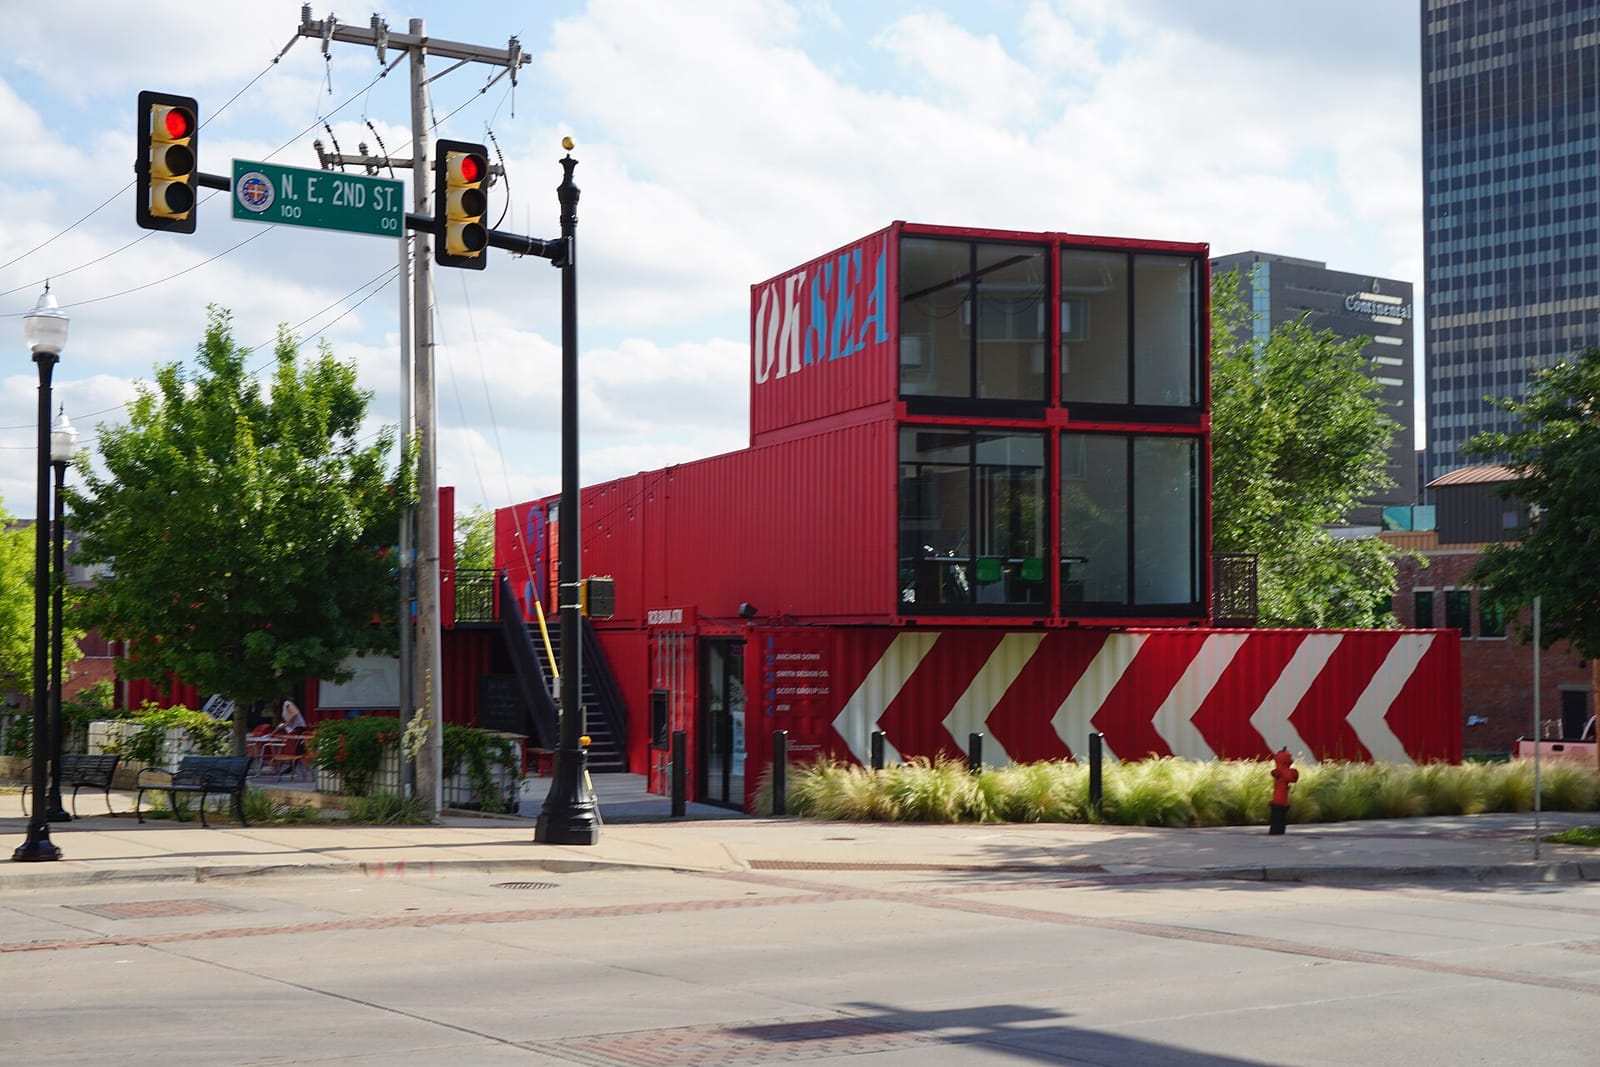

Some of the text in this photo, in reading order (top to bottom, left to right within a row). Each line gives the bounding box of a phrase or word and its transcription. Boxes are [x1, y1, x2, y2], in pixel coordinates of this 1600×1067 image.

[281, 173, 298, 200] N.
[307, 177, 324, 204] E.
[332, 180, 366, 208] 2ND
[373, 186, 398, 213] ST.
[280, 205, 301, 218] 100
[381, 217, 397, 230] 00
[1344, 294, 1412, 320] Continental
[766, 653, 775, 666] 2
[776, 670, 795, 678] SMITH
[795, 670, 818, 678] DESIGN
[776, 687, 796, 695] SCOTT
[796, 687, 817, 695] GROUP
